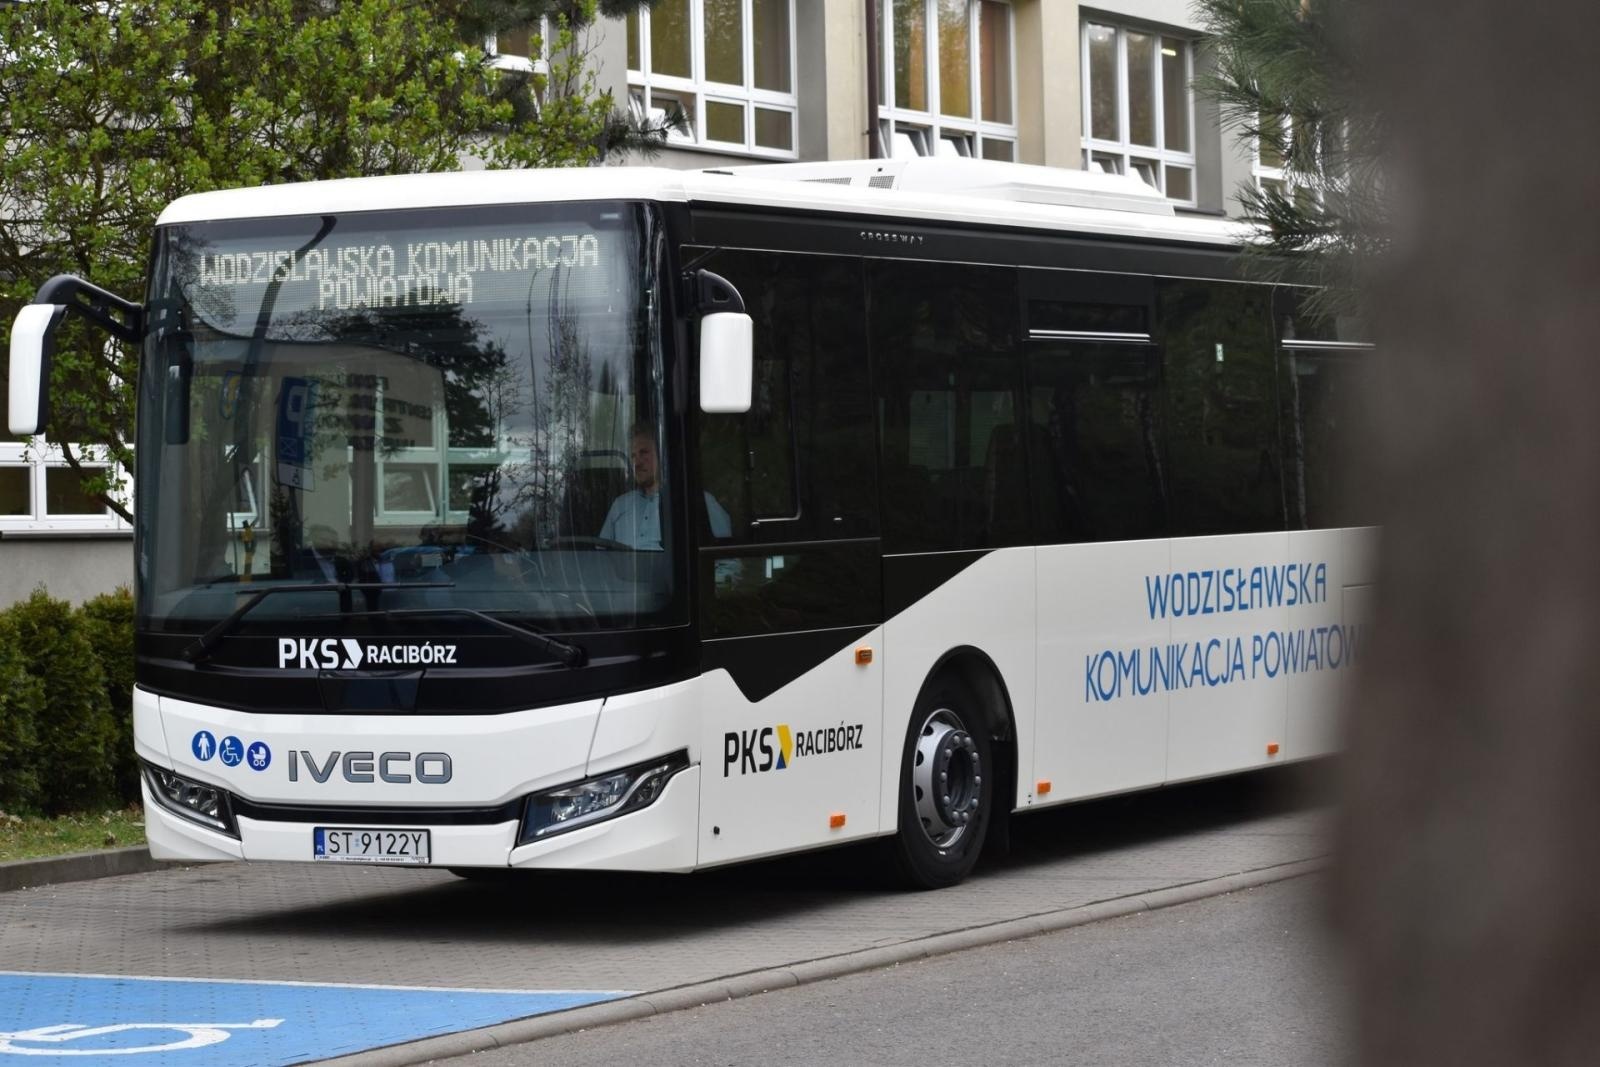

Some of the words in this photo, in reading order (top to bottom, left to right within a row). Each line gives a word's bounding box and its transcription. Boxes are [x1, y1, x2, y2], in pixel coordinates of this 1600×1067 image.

[407, 234, 599, 277] KOMUNIKACJA
[319, 273, 473, 310] POWIATOWA
[1145, 563, 1326, 620] WODZISŁAWSKA
[278, 638, 340, 669] PKS
[367, 641, 457, 664] RACIBÓRZ
[1085, 636, 1246, 703] KOMUNIKACJA
[1252, 624, 1362, 679] POWIATOW
[288, 750, 453, 784] IVECO
[724, 727, 773, 777] PKS
[796, 720, 863, 757] RACIBÓRZ
[328, 831, 353, 854] ST
[361, 832, 422, 855] 9122Y
